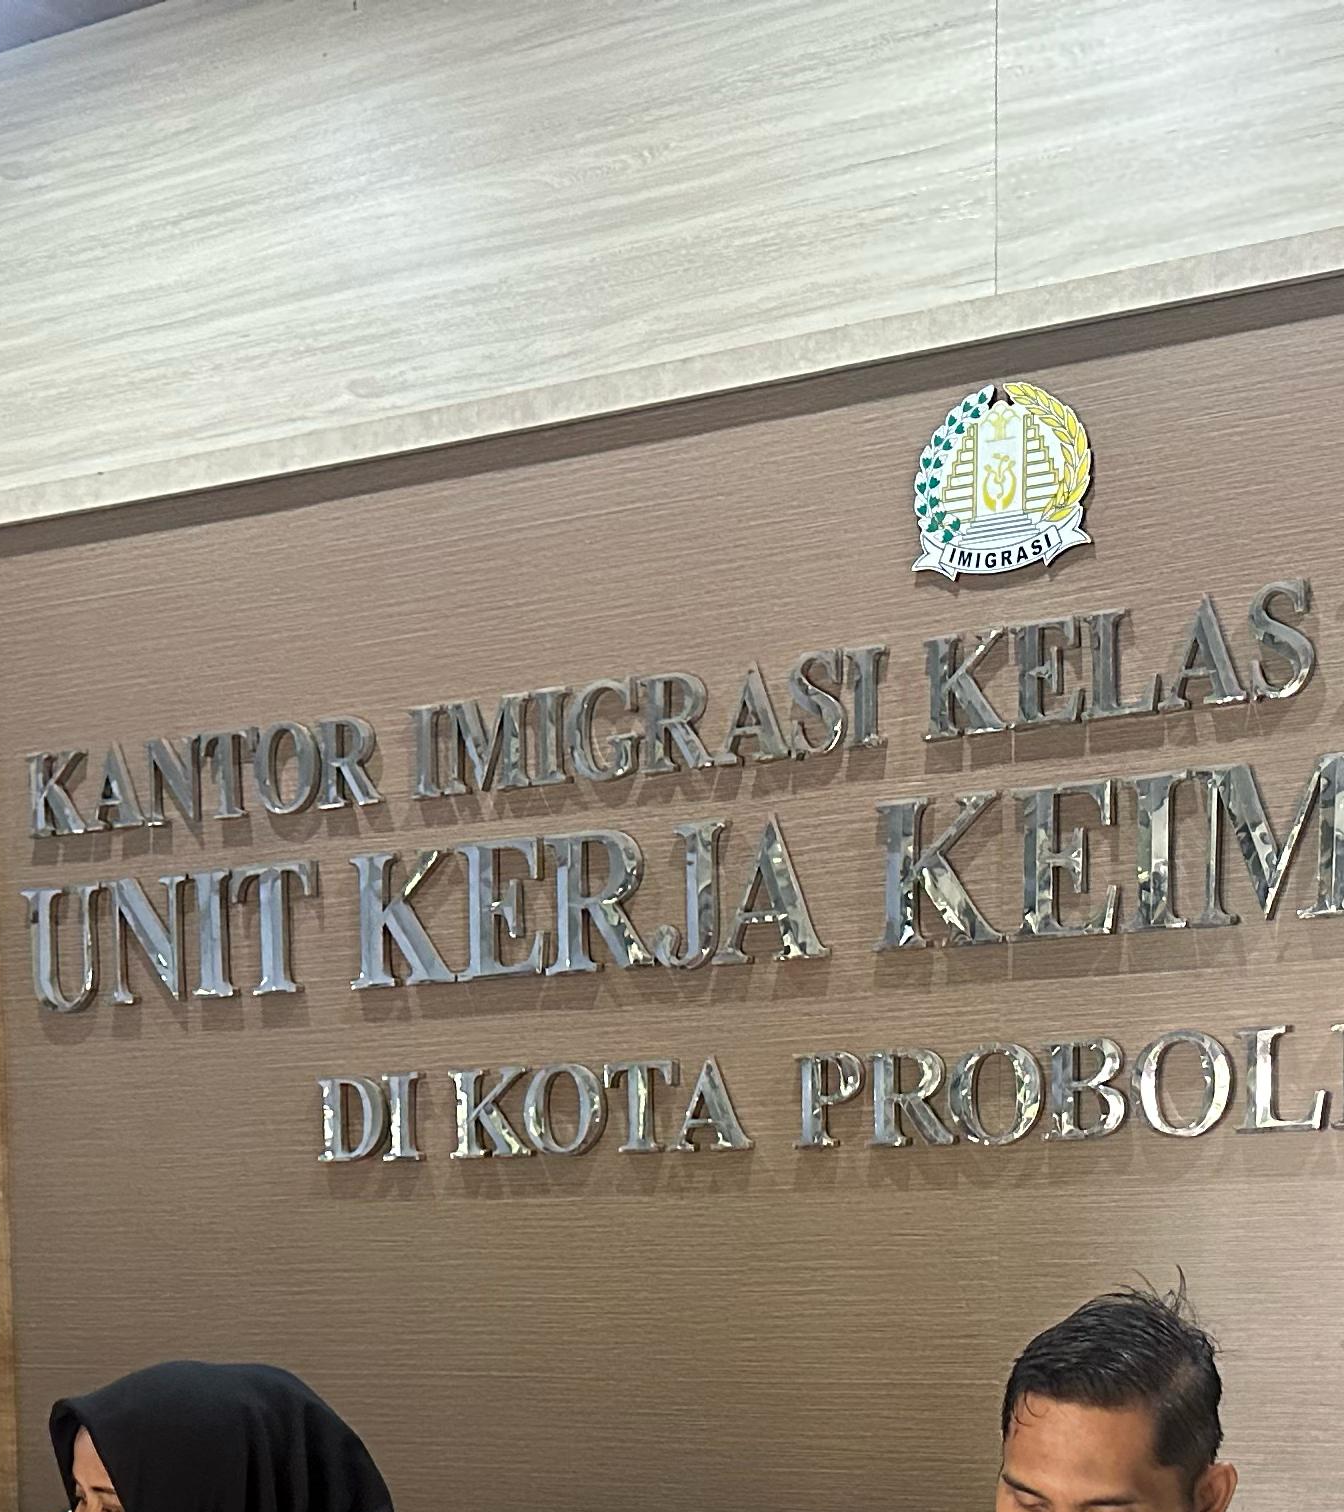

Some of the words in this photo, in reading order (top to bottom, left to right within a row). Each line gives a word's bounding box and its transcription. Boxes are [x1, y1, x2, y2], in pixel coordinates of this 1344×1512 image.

[948, 532, 1052, 569] IMIGRASI
[27, 714, 382, 838] KANTOR
[409, 643, 890, 800] IMIGRASI
[923, 576, 1315, 743] KELAS
[21, 858, 320, 1013] UNIT
[348, 811, 831, 992] KERJA
[317, 1069, 425, 1164] DI
[448, 1054, 756, 1163] KOTA
